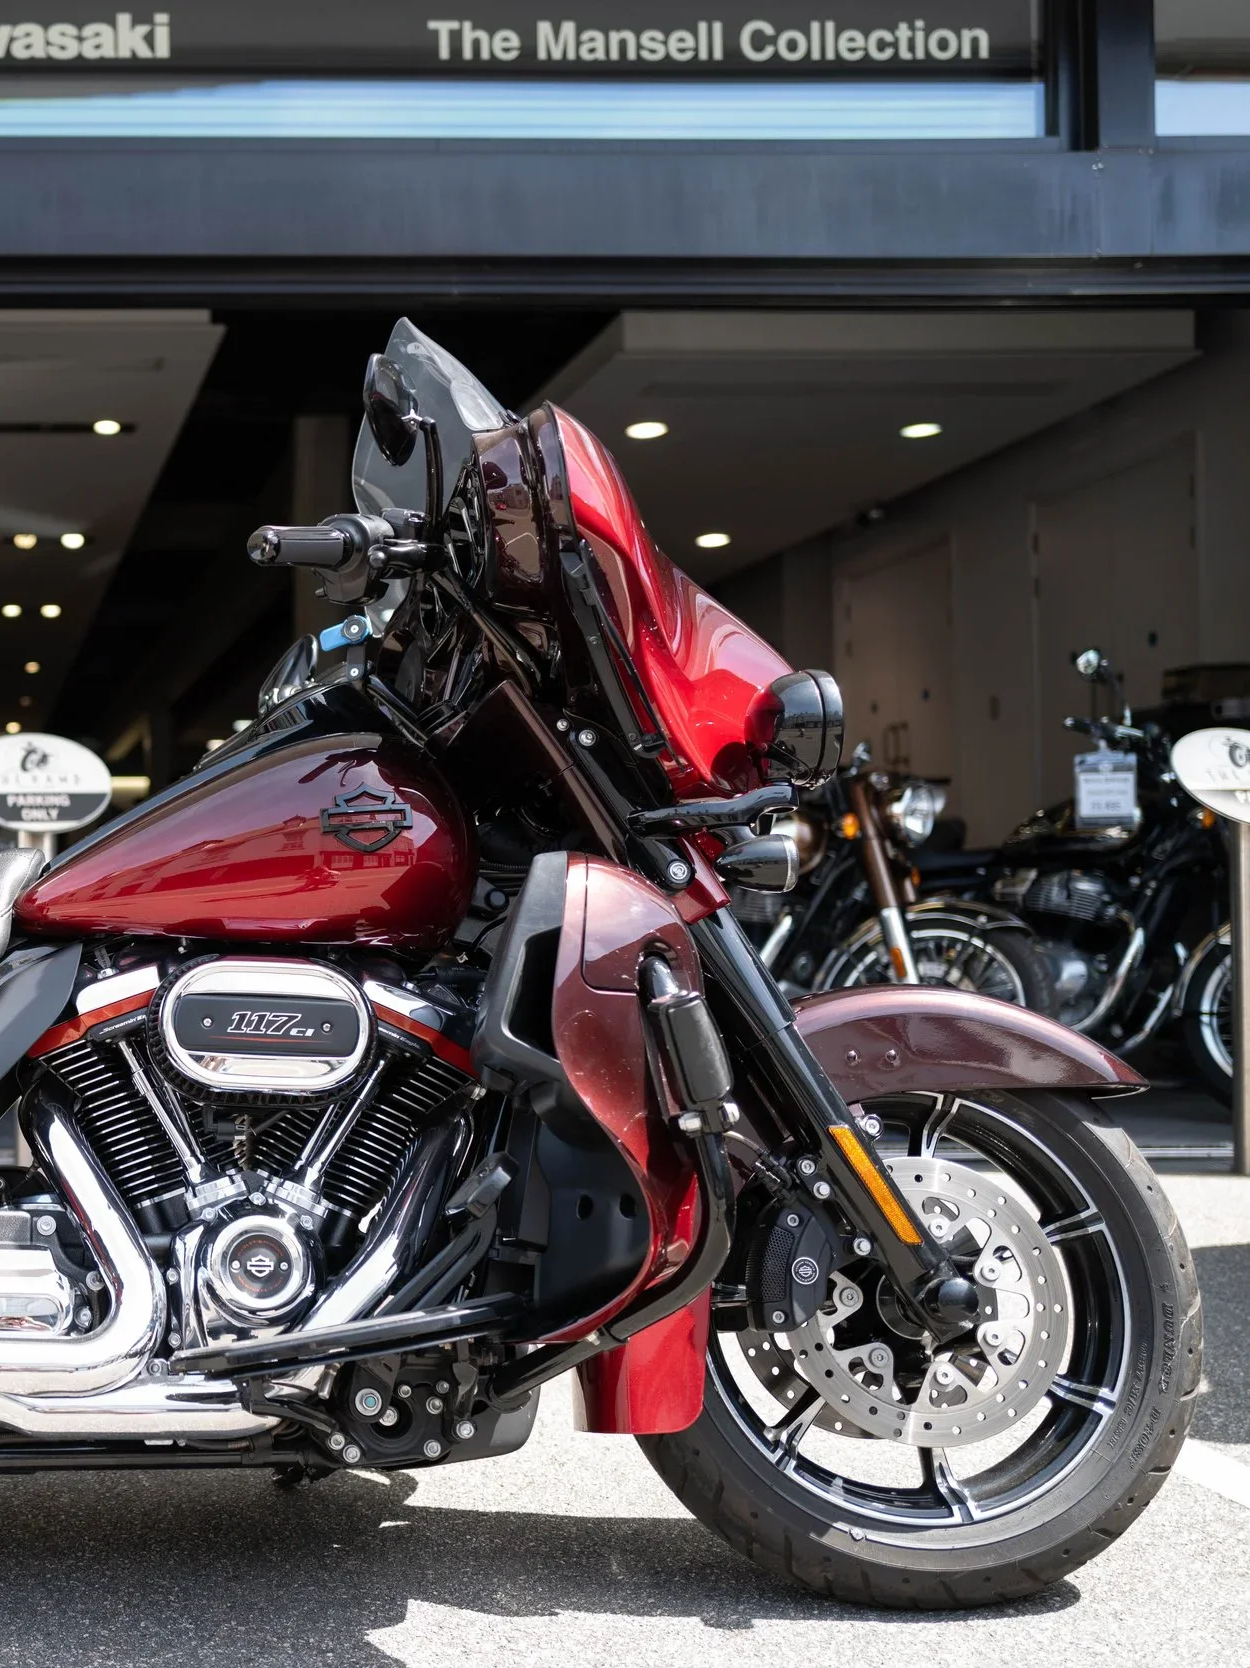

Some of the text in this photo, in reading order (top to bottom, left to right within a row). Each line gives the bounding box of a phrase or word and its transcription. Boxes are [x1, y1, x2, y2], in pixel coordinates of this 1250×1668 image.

[426, 19, 989, 62] The Mansell Collection
[6, 793, 71, 807] PARKING
[21, 807, 59, 821] ONLY
[227, 1011, 302, 1035] 117
[1158, 1301, 1175, 1396] DUNLOP
